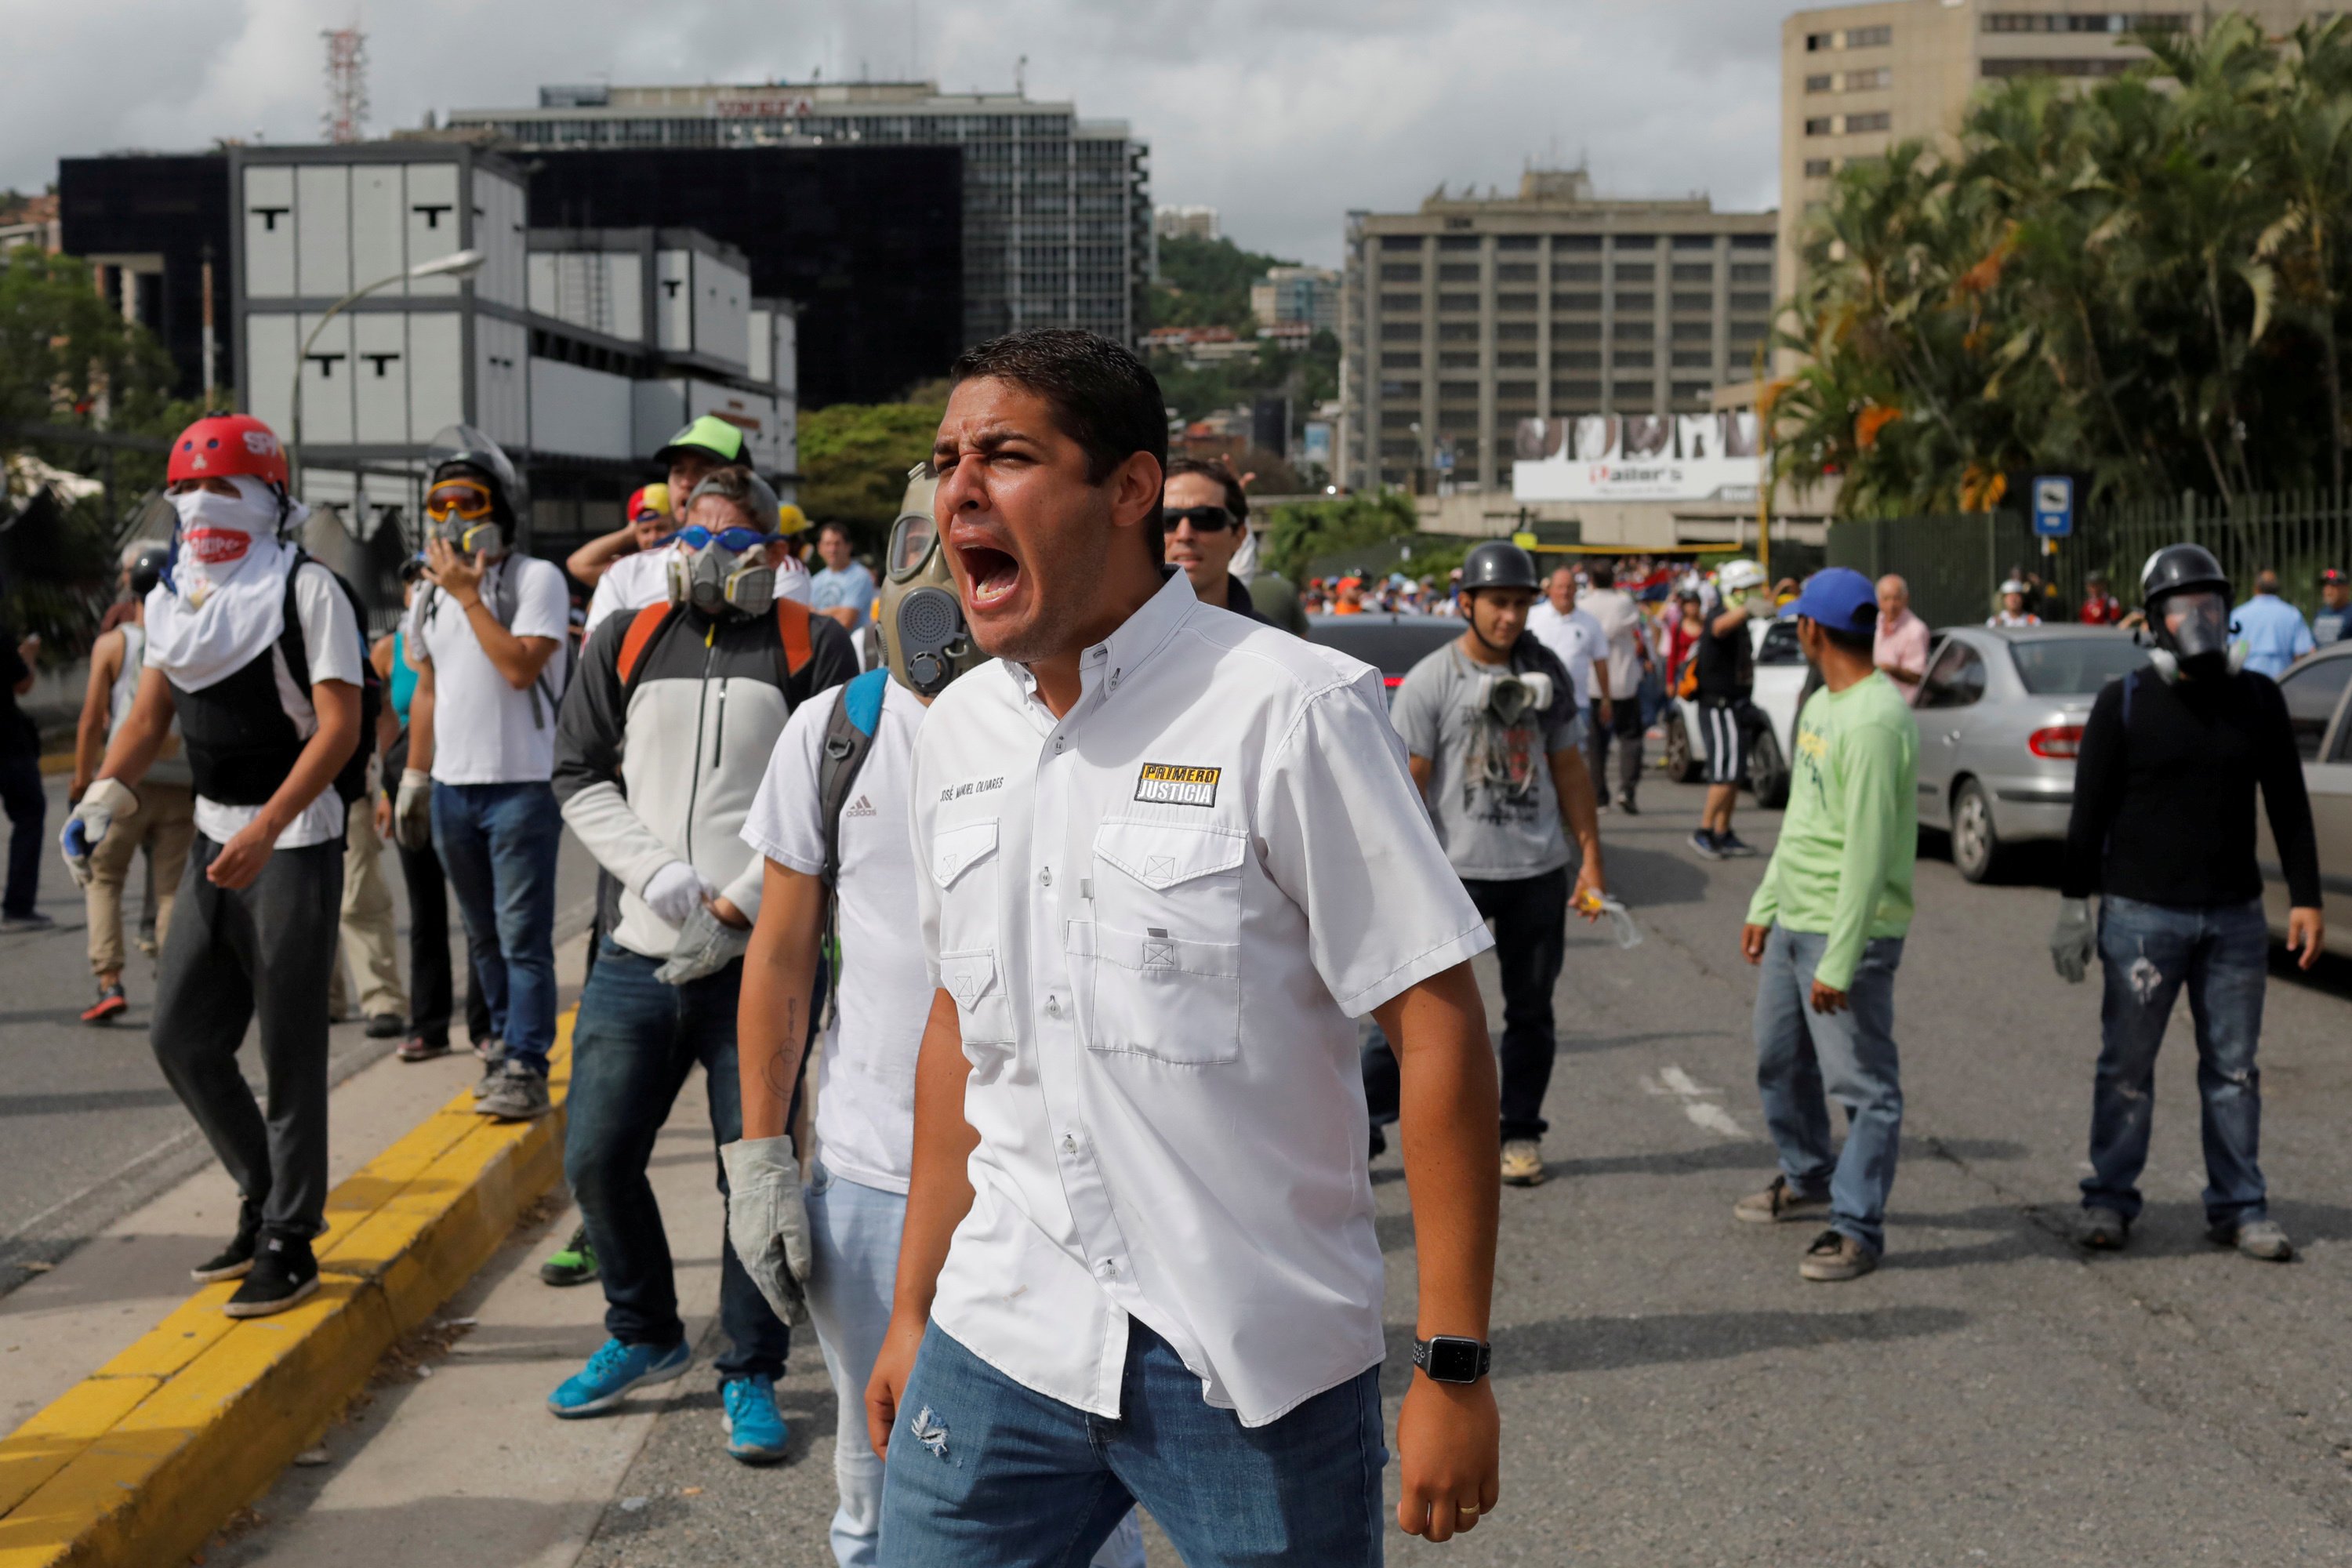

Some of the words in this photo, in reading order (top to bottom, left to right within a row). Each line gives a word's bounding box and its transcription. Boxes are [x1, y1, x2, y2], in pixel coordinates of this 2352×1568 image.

[1145, 765, 1215, 783] PRIMERO
[940, 785, 954, 802] JOSÉ
[1137, 779, 1211, 804] JUSTICIA
[846, 808, 877, 817] adidas
